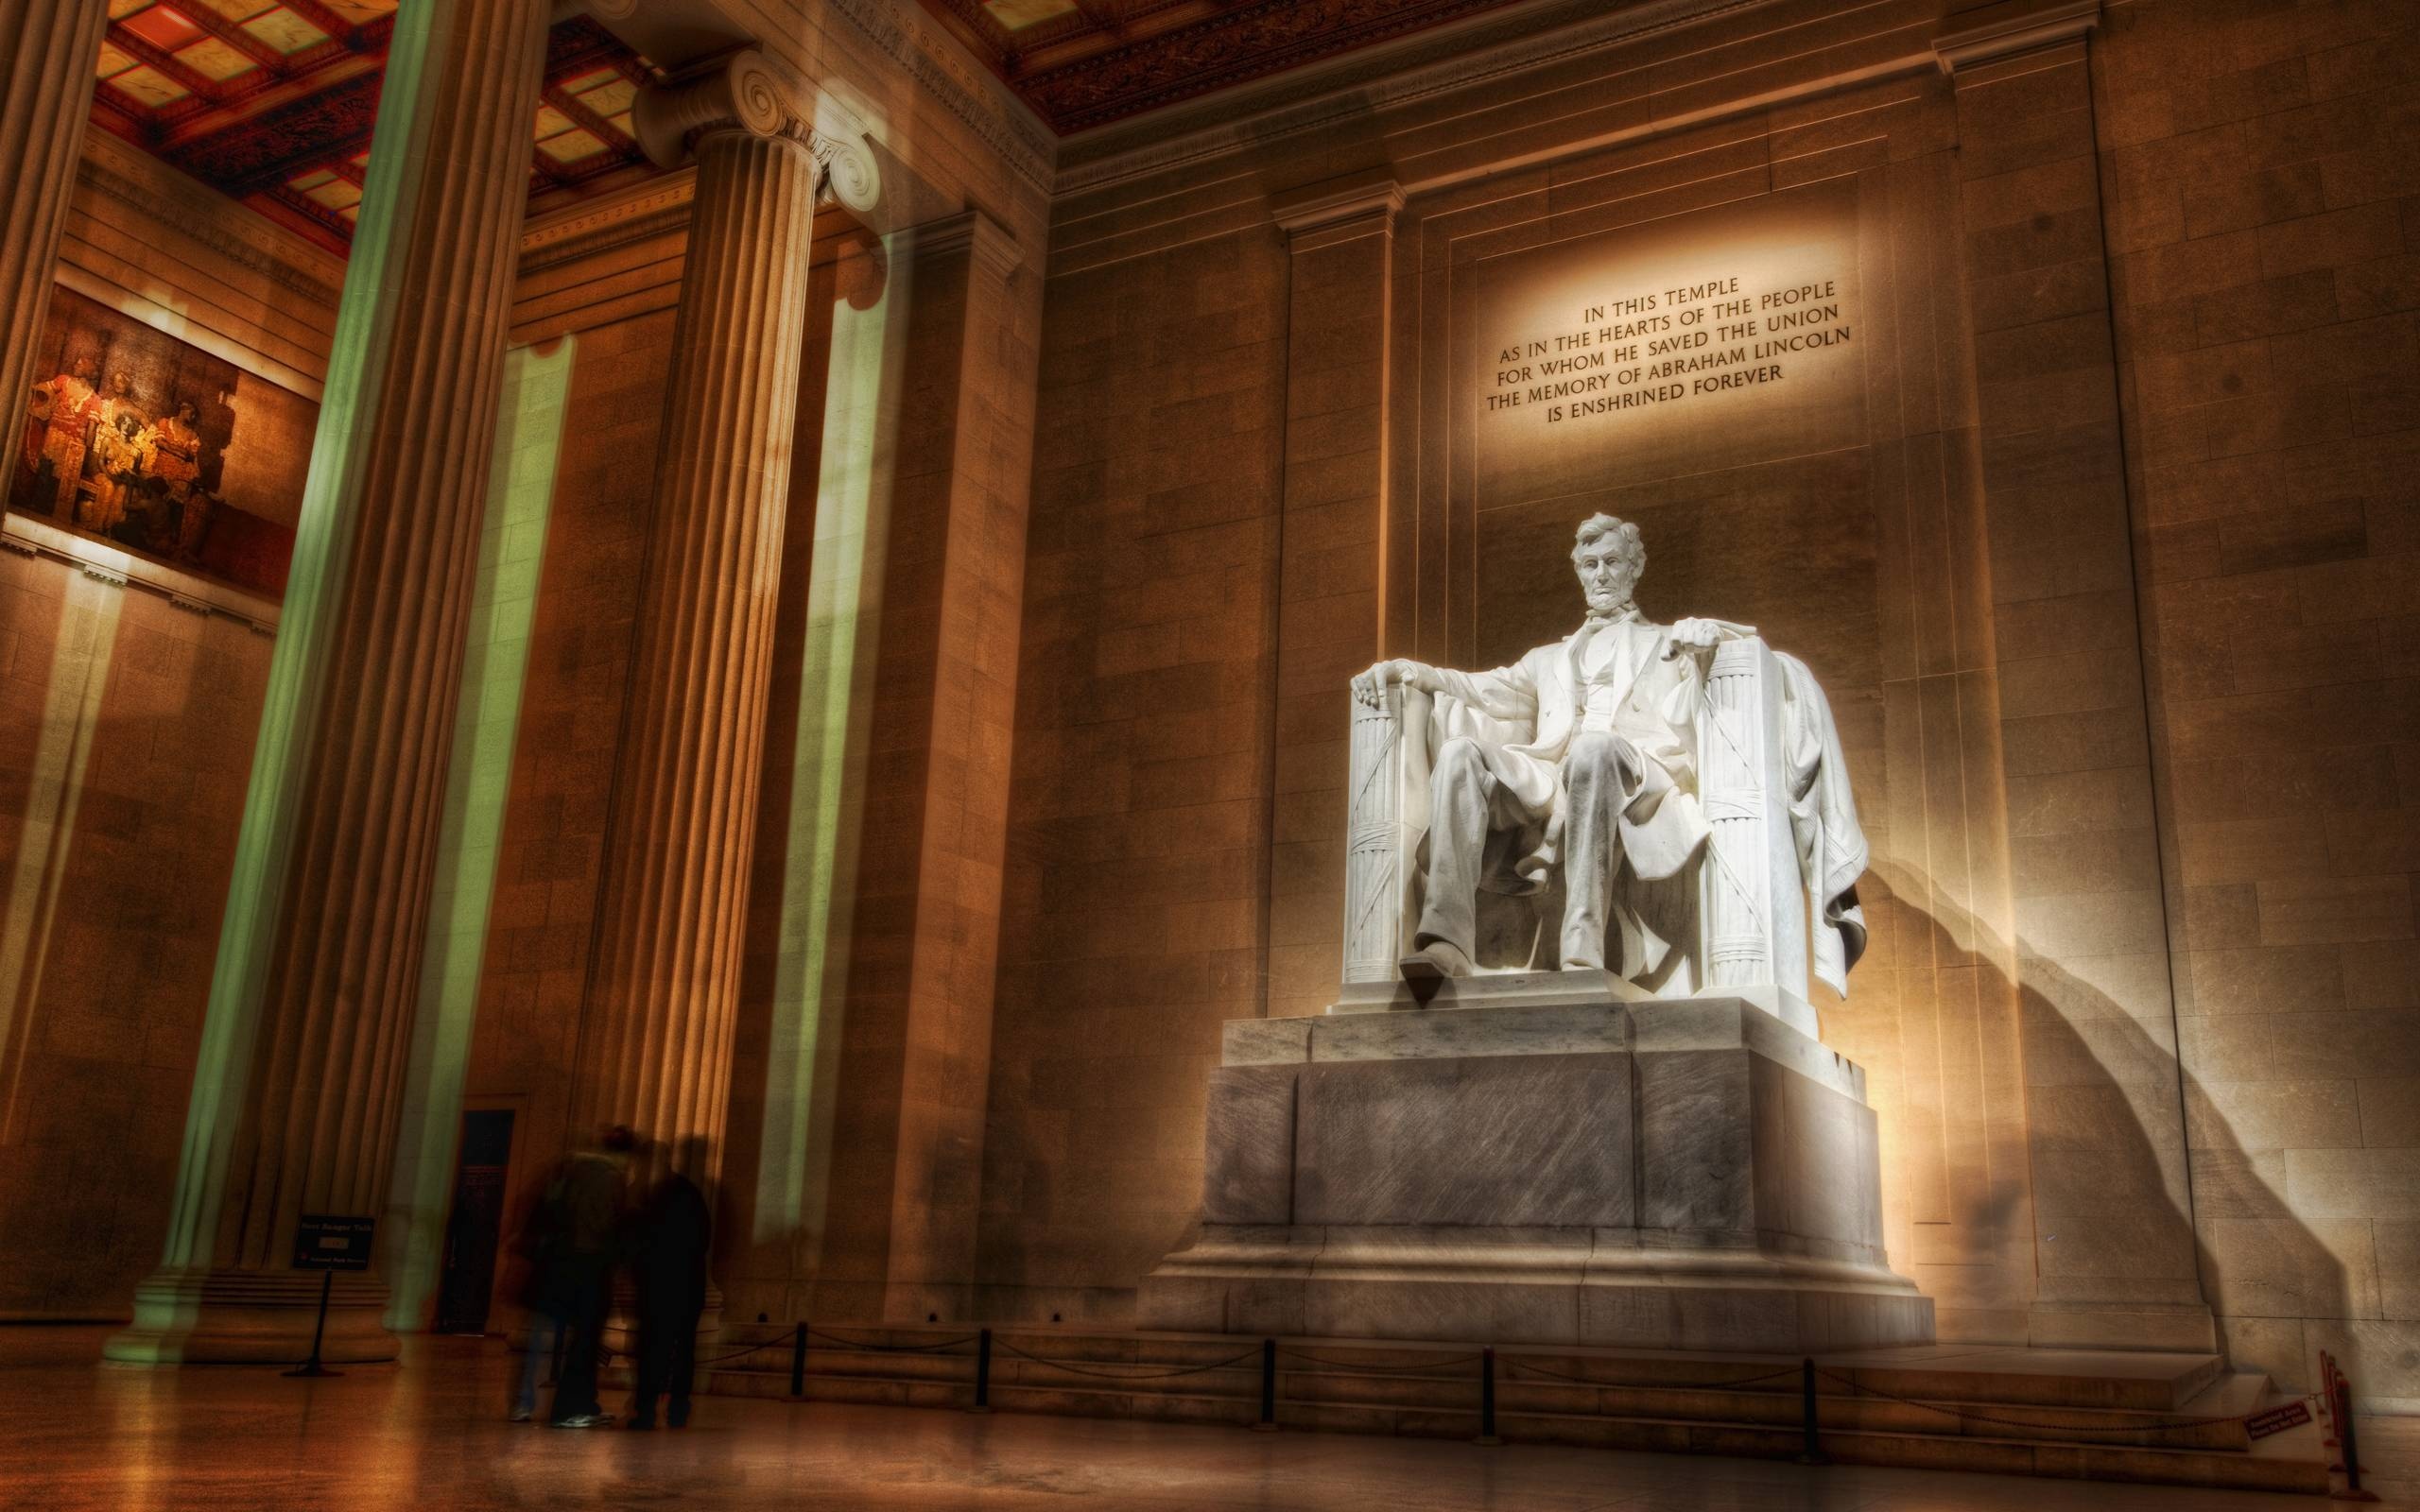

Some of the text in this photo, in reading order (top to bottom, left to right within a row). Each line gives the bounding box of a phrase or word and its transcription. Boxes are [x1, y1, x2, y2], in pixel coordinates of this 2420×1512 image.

[1499, 281, 1835, 364] AS IN THE HEARTS OF THE PEOPLE
[1584, 277, 1739, 324] IN THIS TEMPLE
[1486, 326, 1851, 411] THE MEMORY OF ABRAHAM LINCOLN
[1497, 303, 1839, 387] FOR WHOM HE SAVED THE UNION
[1547, 364, 1784, 423] IS ENSHRINED FOREVER
